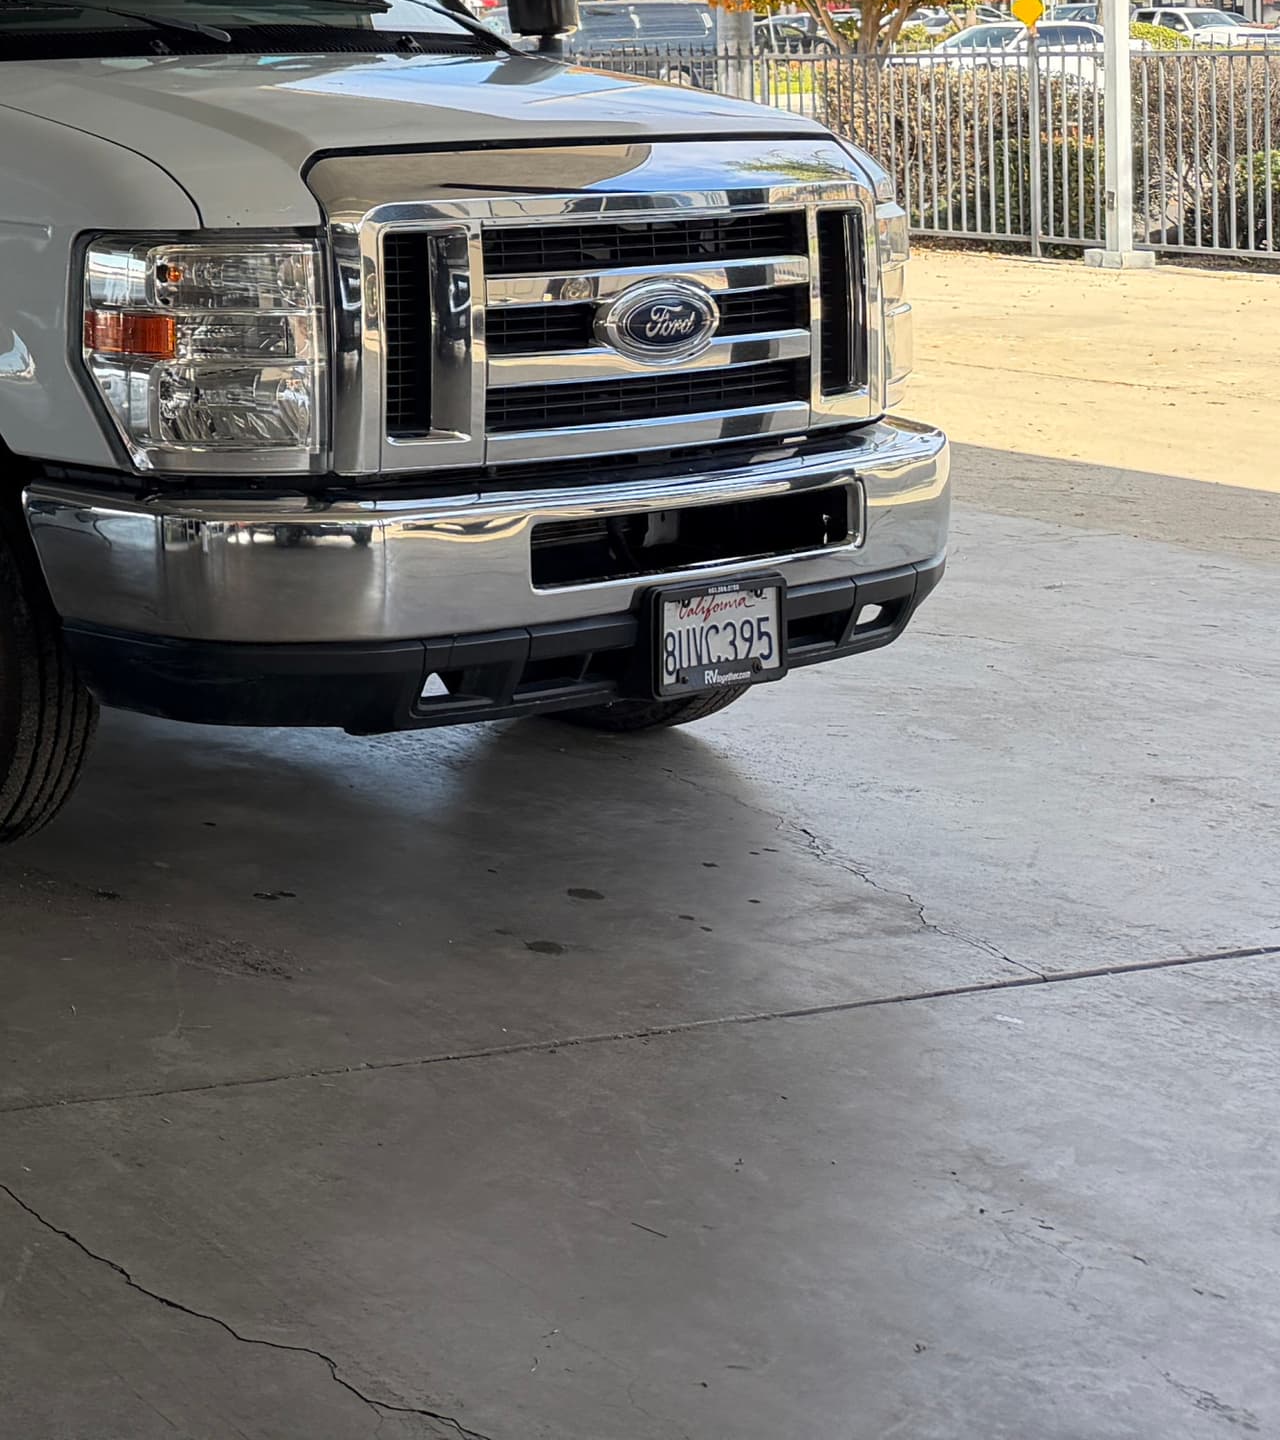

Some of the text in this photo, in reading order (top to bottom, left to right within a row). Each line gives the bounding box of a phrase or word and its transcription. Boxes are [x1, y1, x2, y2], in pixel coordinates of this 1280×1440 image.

[646, 305, 695, 337] Ford
[678, 594, 755, 622] California
[664, 616, 772, 676] 8UVC395
